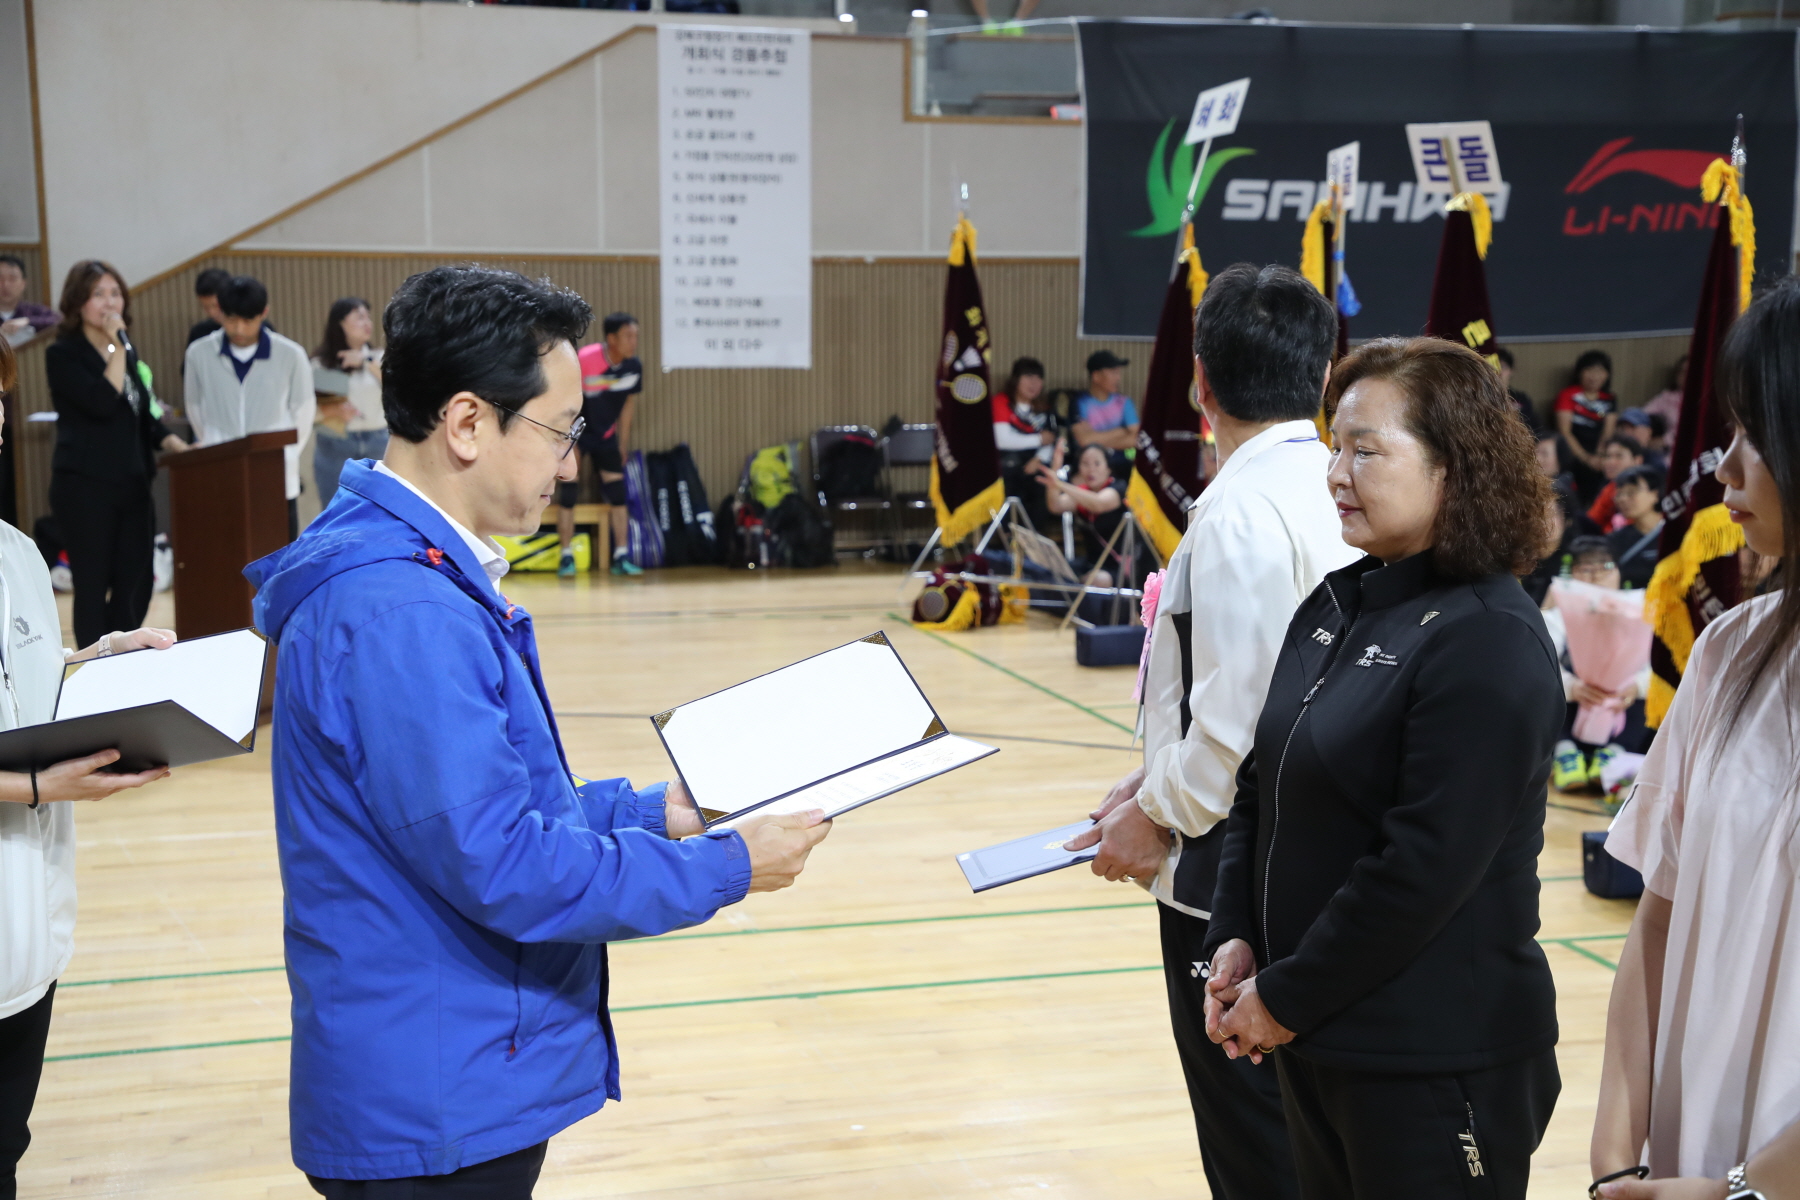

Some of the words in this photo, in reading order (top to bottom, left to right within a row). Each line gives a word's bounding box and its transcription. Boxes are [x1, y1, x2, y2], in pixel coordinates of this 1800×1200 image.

[682, 46, 725, 60] 개회식
[732, 48, 787, 63] 경품추첨
[1564, 203, 1722, 236] LI-NIN
[738, 338, 762, 350] 다수
[1311, 627, 1335, 646] TRS
[1457, 1133, 1485, 1178] TRS
